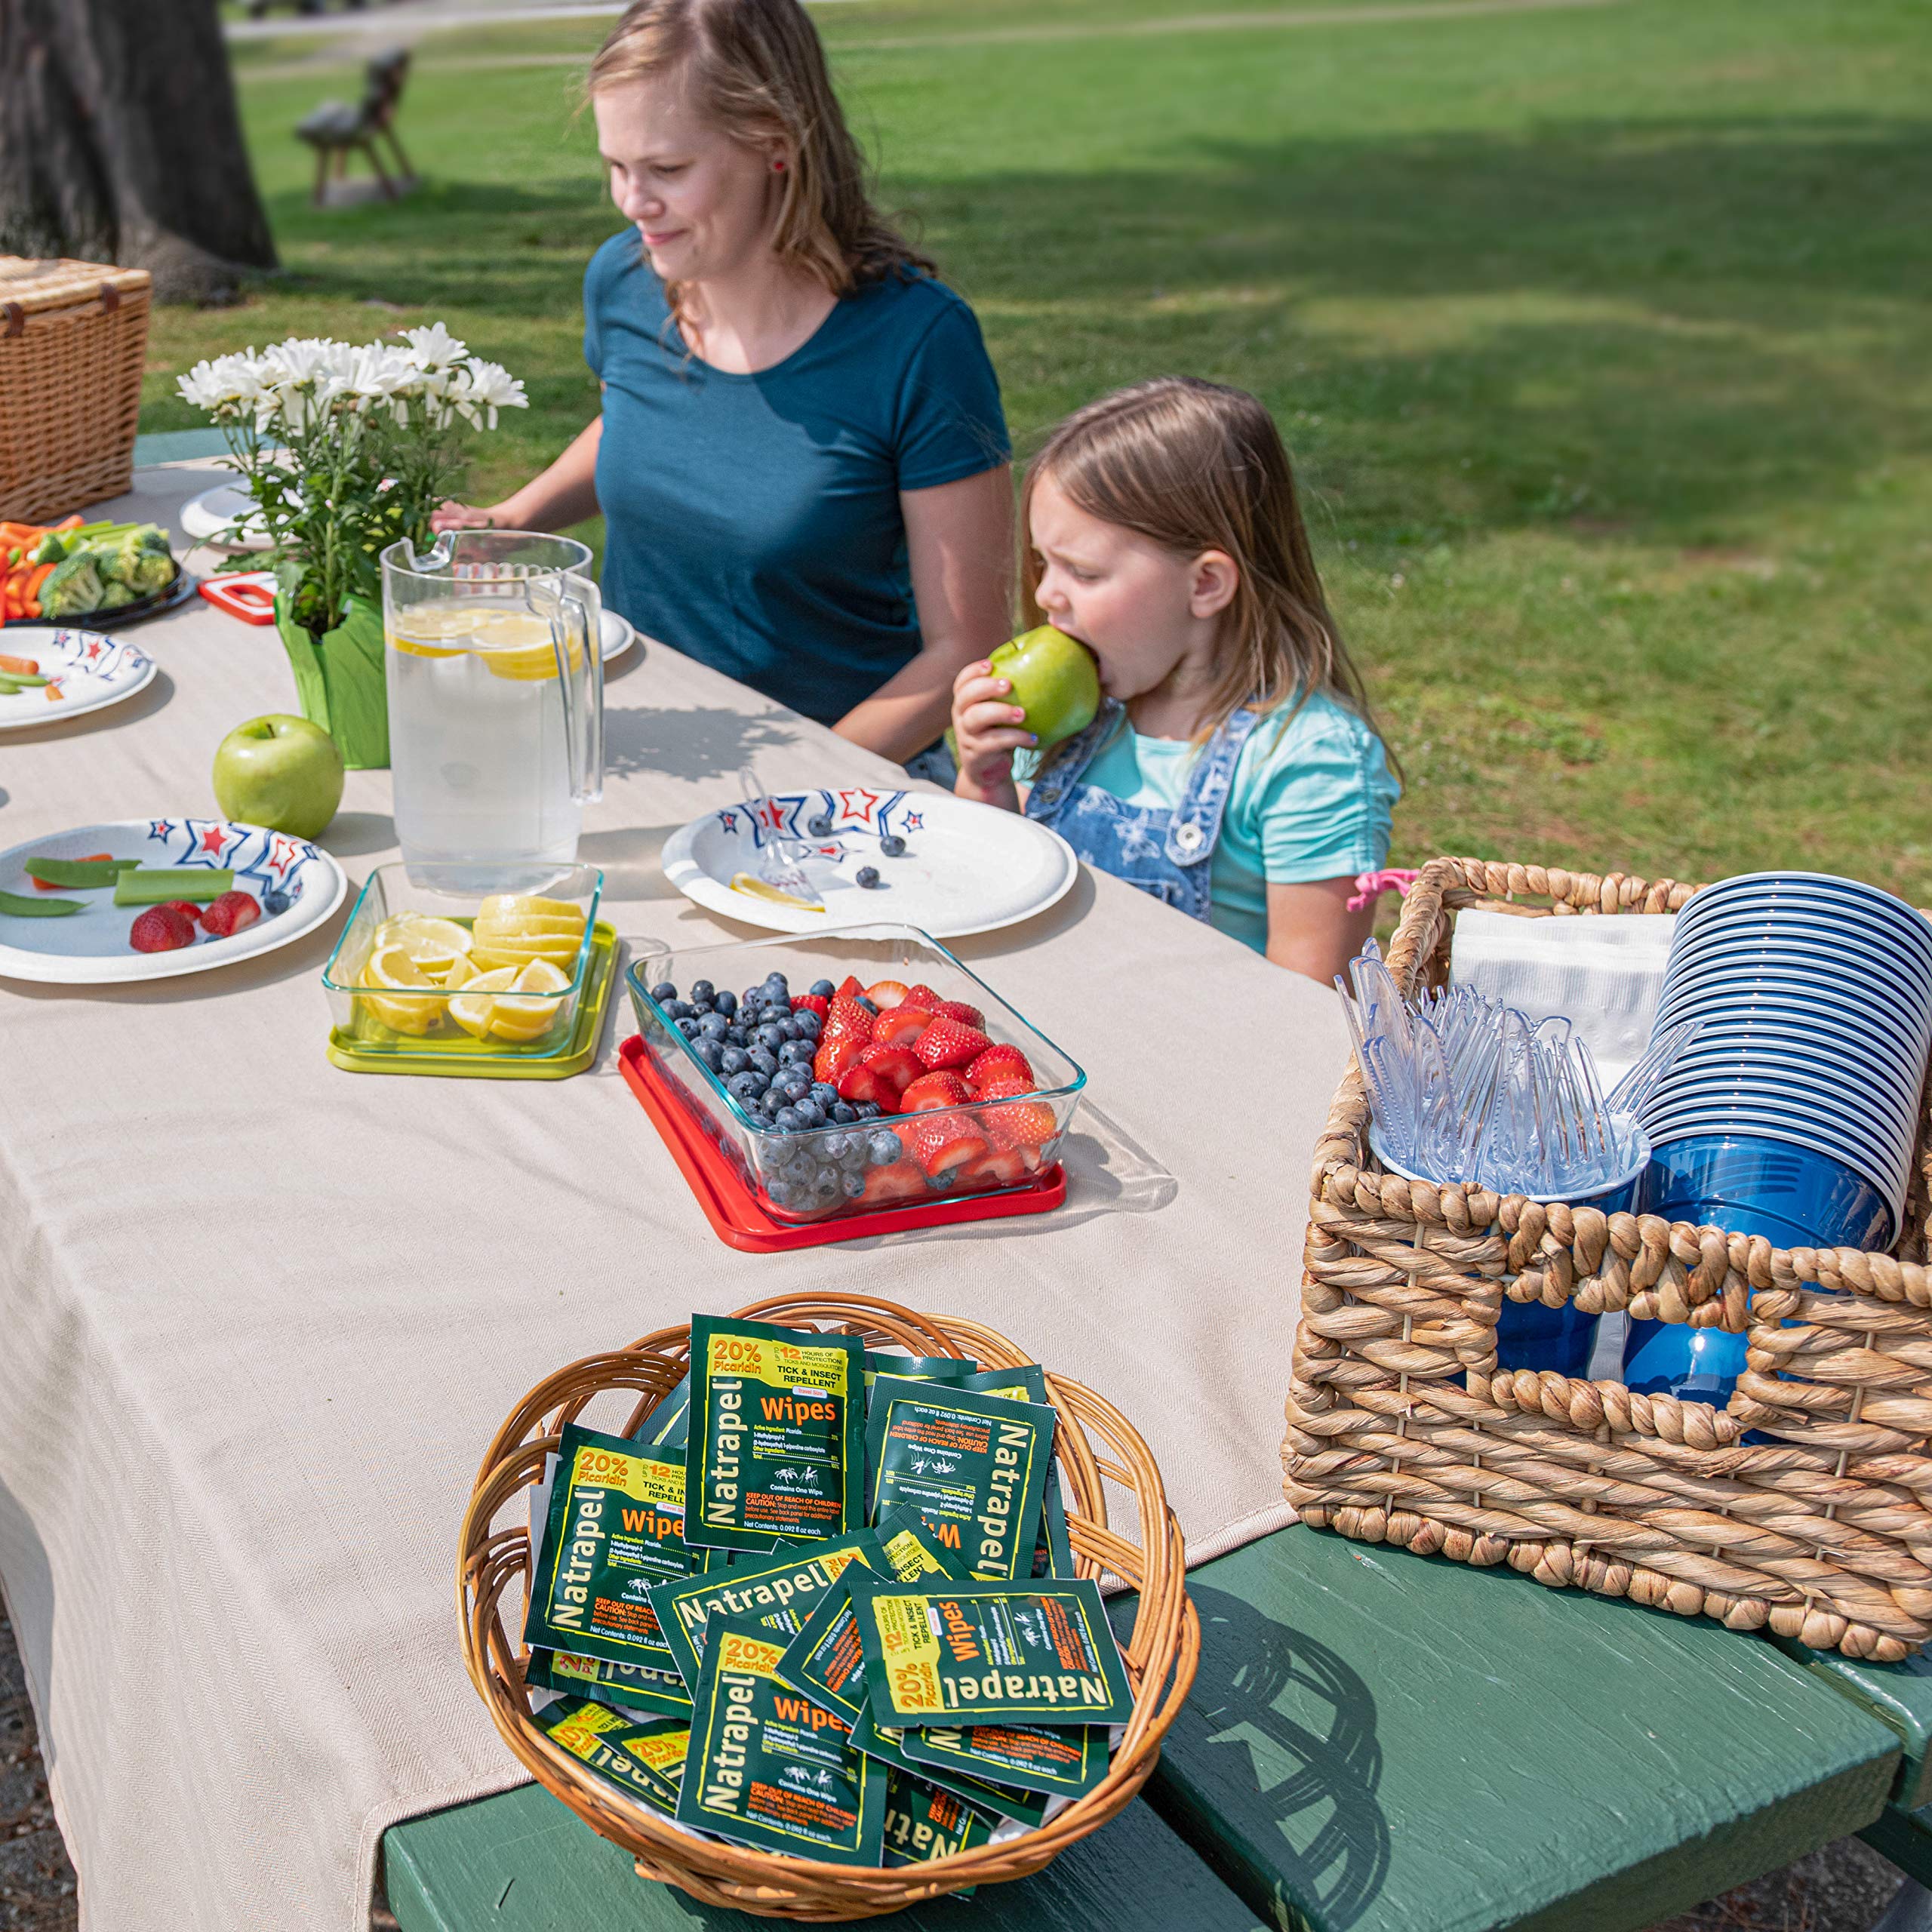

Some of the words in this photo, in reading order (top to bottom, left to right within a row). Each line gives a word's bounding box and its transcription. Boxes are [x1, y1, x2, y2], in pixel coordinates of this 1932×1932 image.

[713, 1340, 761, 1362] 20%
[780, 1346, 801, 1359] 12
[713, 1360, 761, 1374] Picaridin
[777, 1365, 798, 1374] TICK
[811, 1370, 841, 1380] INSECT
[783, 1374, 835, 1388] REPELLENT
[761, 1396, 835, 1426] Wipes
[940, 1411, 955, 1419] 0.092
[955, 1413, 980, 1423] Contents:
[980, 1417, 992, 1426] Net
[889, 1430, 918, 1442] CHILDREN
[928, 1437, 948, 1447] REACH
[955, 1435, 988, 1447] CAUTION:
[708, 1378, 748, 1524] Natrapel
[907, 1442, 923, 1451] Wipe
[936, 1447, 961, 1460] Contains
[958, 1442, 971, 1451] OUT
[971, 1444, 987, 1454] KEEP
[580, 1451, 629, 1476] 20%
[648, 1463, 671, 1478] 12
[578, 1471, 627, 1487] Picaridin
[642, 1481, 664, 1491] TICK
[770, 1484, 795, 1492] Contains
[648, 1491, 685, 1504] REPELL
[746, 1497, 776, 1507] CAUTION:
[814, 1499, 841, 1509] CHILDREN
[977, 1423, 1030, 1577] Natrapel
[621, 1509, 684, 1540] Wipe
[754, 1521, 779, 1531] Contents:
[552, 1487, 606, 1628] Natrapel
[620, 1592, 647, 1603] Contains
[594, 1603, 626, 1616] CAUTION:
[595, 1597, 611, 1606] KEEP
[611, 1601, 625, 1609] OUT
[635, 1605, 654, 1616] REACH
[903, 1599, 915, 1622] INSECT
[914, 1602, 931, 1643] REPELLENT
[589, 1625, 600, 1633] Net
[601, 1628, 626, 1639] Contents:
[626, 1634, 643, 1643] 0.092
[939, 1600, 981, 1662] Wipes
[884, 1629, 902, 1654] 12
[910, 1632, 921, 1649] TICK
[725, 1638, 779, 1665] 20%
[895, 1663, 924, 1708] 20%
[924, 1662, 938, 1708] Picaridin
[943, 1669, 1107, 1708] Natrapel
[704, 1672, 758, 1813] Natrapel
[806, 1786, 820, 1798] One
[820, 1791, 837, 1803] Wipe
